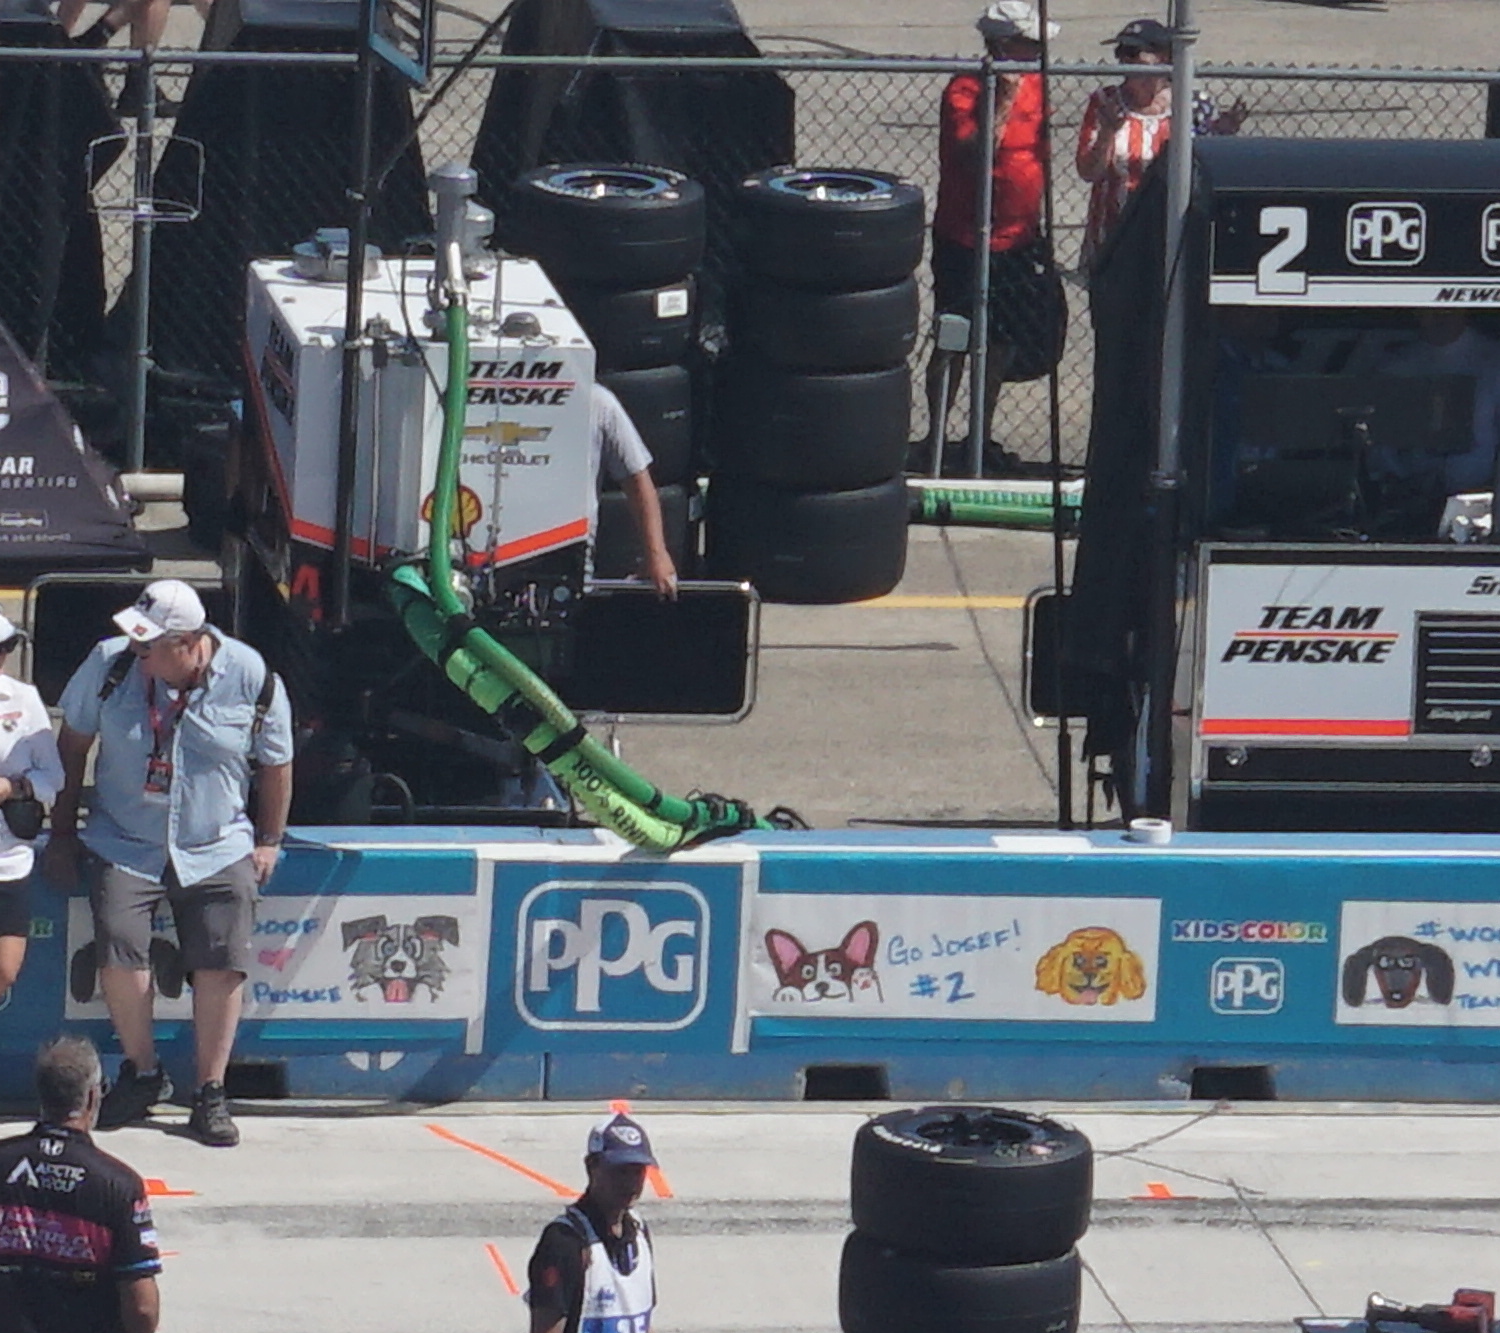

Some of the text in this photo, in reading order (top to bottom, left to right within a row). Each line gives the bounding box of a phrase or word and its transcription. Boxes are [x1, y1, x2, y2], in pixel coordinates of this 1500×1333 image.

[1257, 206, 1308, 293] 2
[1351, 209, 1422, 260] PPG
[469, 360, 565, 379] TEAM
[466, 387, 573, 406] ENSKE
[1258, 607, 1383, 630] TEAM
[1221, 639, 1397, 664] PENSKE
[531, 899, 695, 1012] PPG
[887, 936, 927, 968] Go
[908, 969, 977, 1002] #2
[1217, 964, 1281, 1009] PPG
